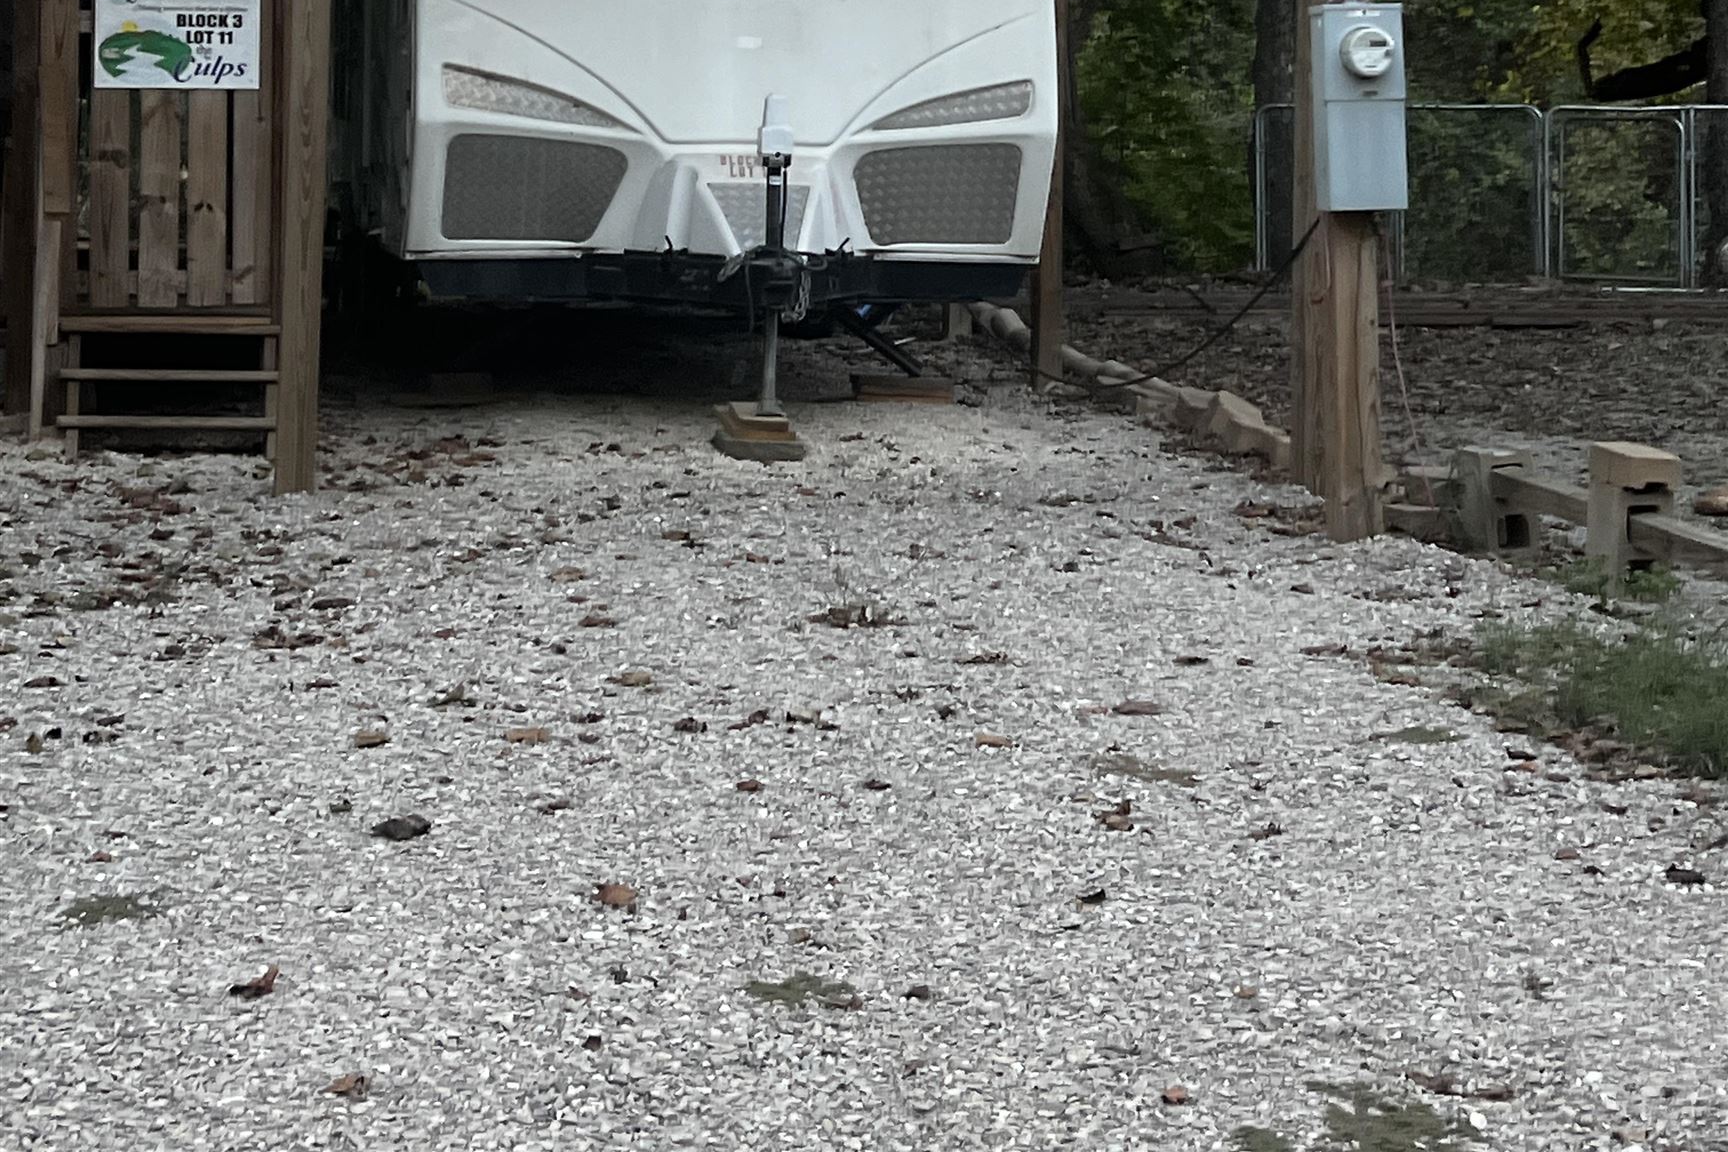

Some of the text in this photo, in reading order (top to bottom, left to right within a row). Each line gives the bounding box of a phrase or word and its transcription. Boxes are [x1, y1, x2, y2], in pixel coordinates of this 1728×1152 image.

[176, 13, 243, 28] BLOCK 3
[186, 30, 233, 44] LOT 11
[174, 55, 248, 84] Culps
[730, 166, 753, 178] LOT
